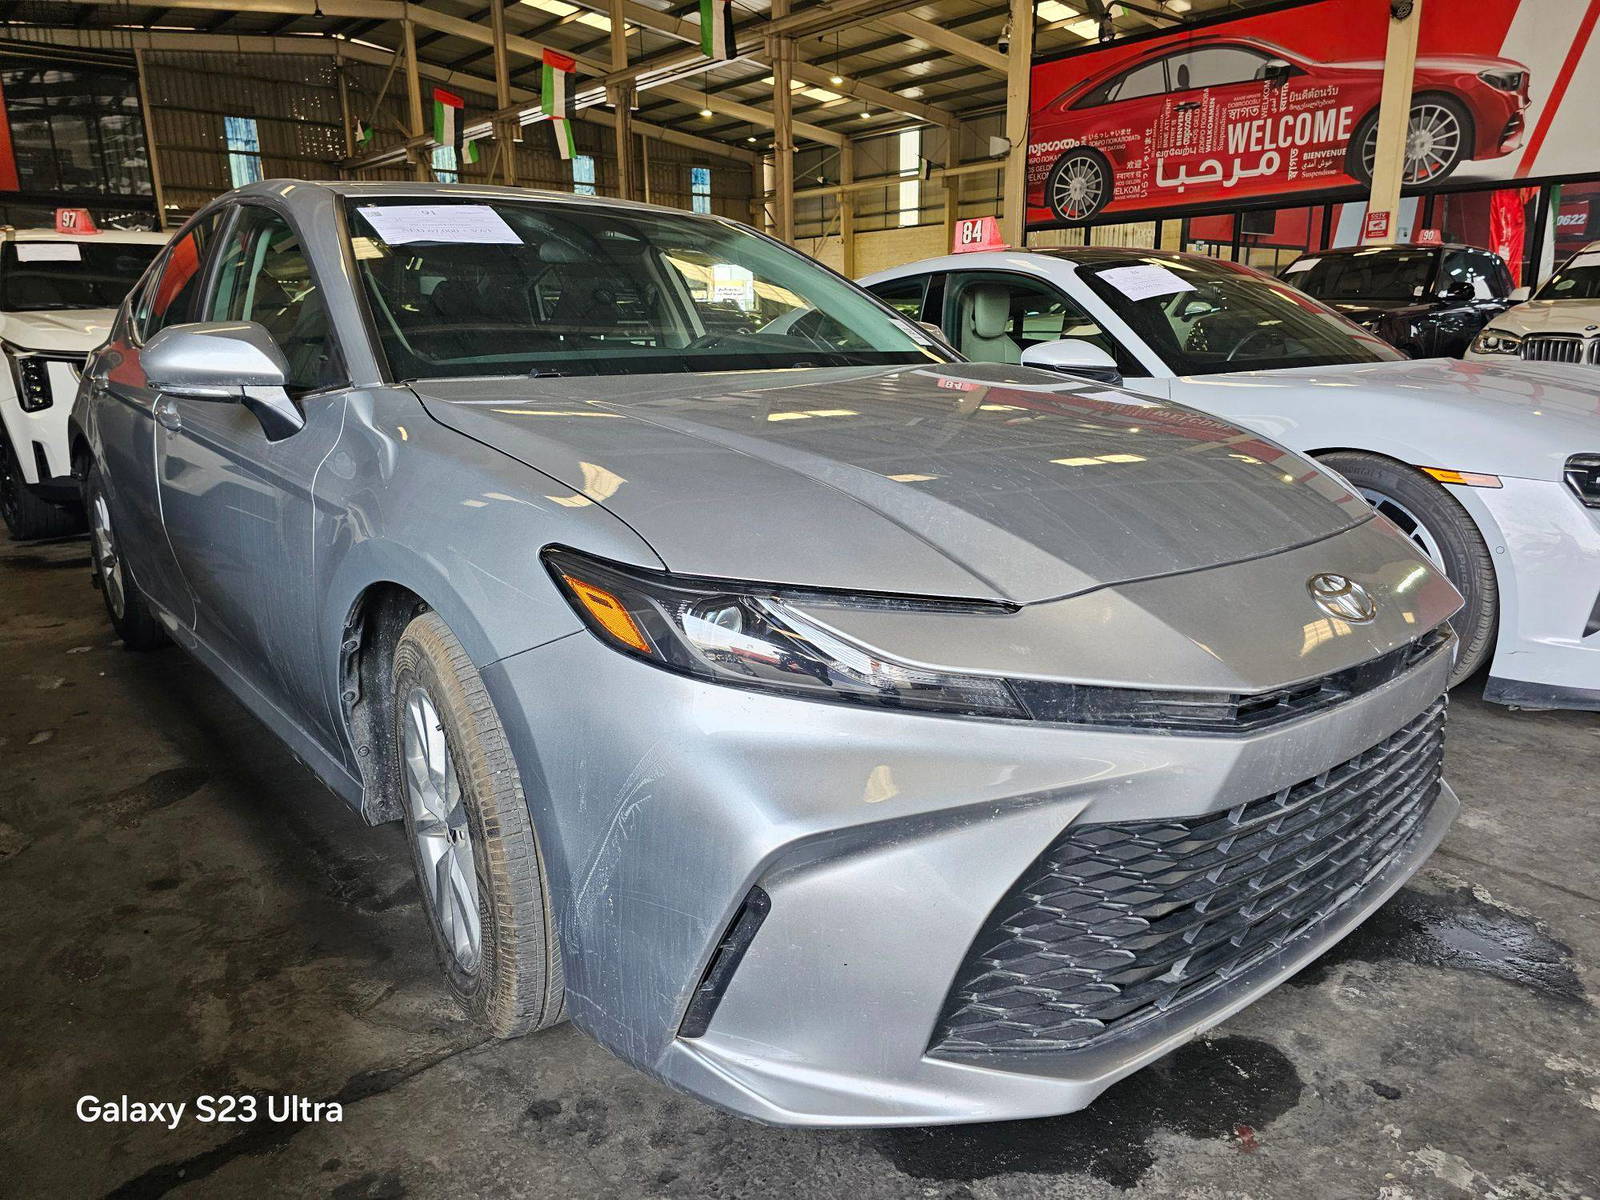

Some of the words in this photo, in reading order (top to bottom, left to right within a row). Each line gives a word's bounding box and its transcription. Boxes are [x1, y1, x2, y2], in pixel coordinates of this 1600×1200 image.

[1206, 97, 1216, 153] WILLKOMMEN
[1227, 106, 1353, 155] WELCOME
[1303, 148, 1347, 161] BIENVENUE
[1028, 172, 1050, 182] ELKO
[1156, 151, 1281, 193] مرحبا
[62, 211, 77, 228] 97
[1556, 213, 1588, 226] 0622
[962, 219, 982, 244] 84
[1423, 230, 1434, 241] 90
